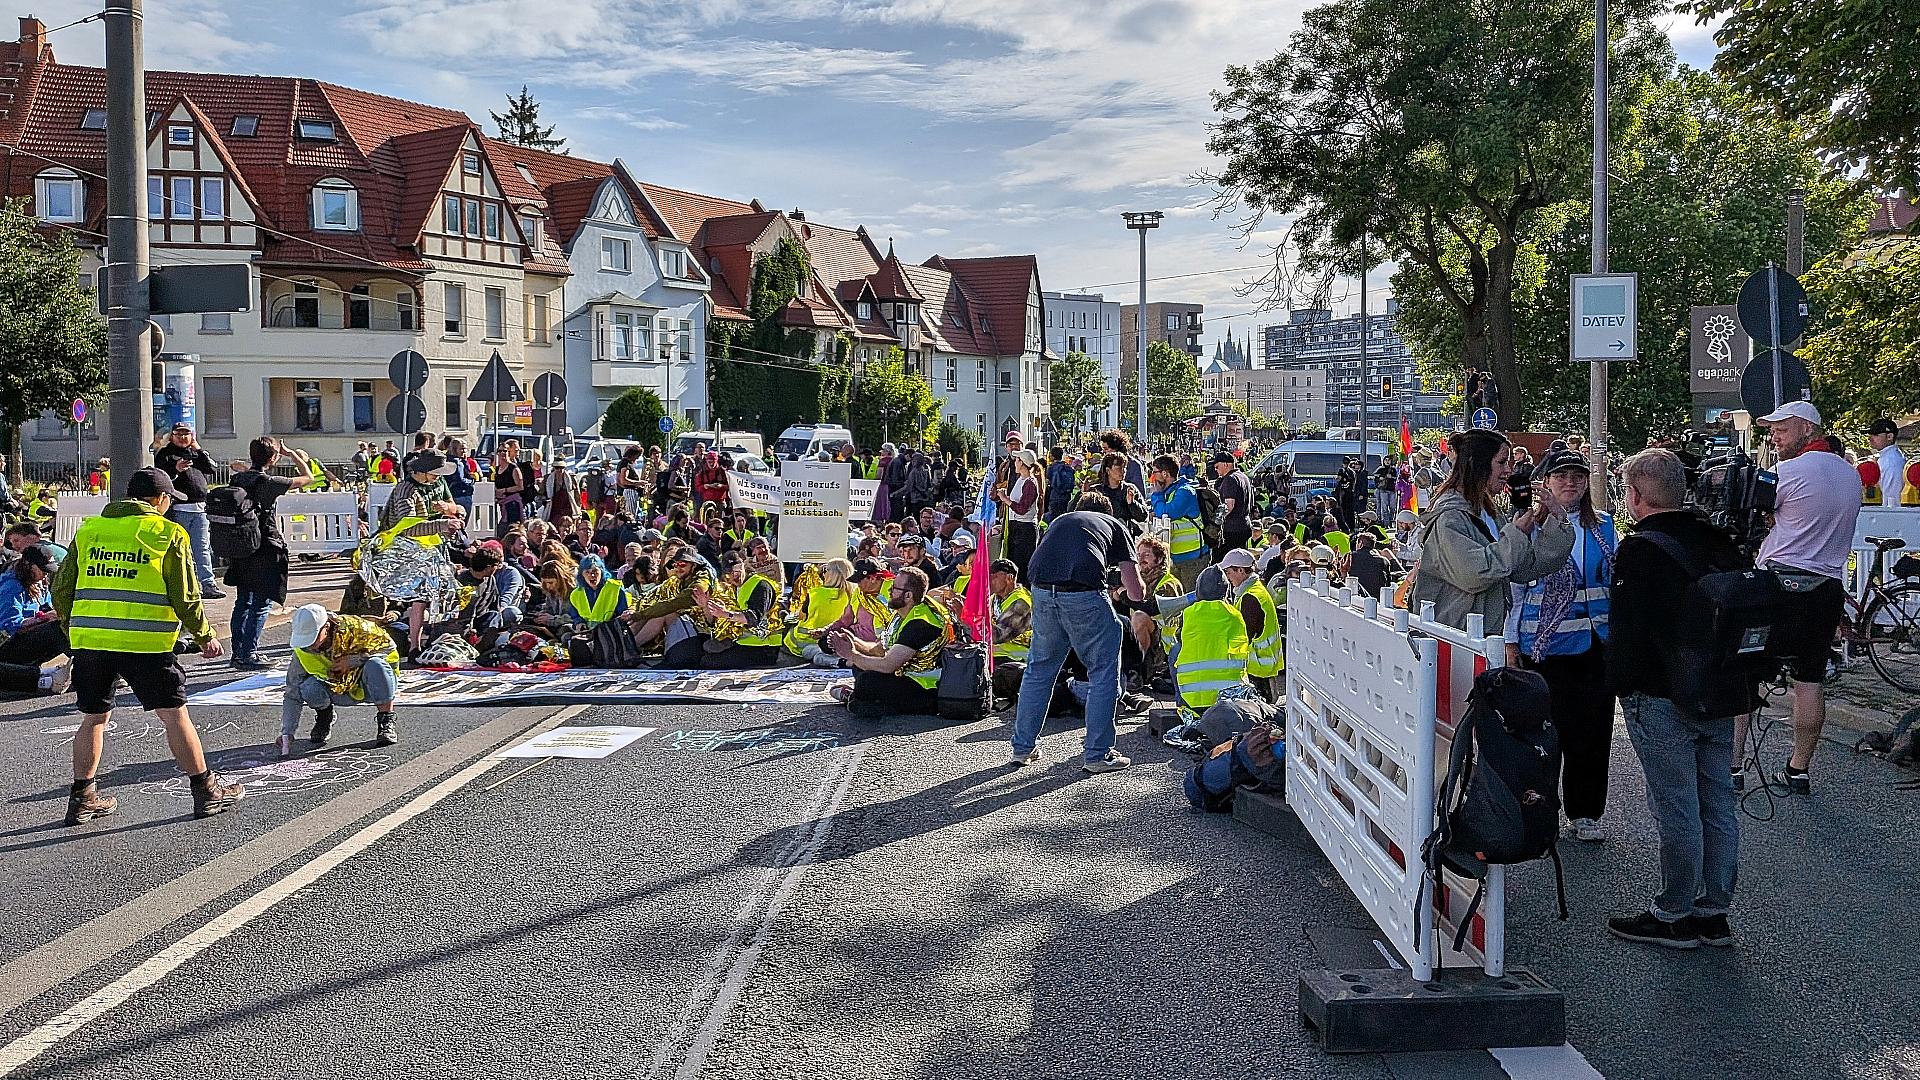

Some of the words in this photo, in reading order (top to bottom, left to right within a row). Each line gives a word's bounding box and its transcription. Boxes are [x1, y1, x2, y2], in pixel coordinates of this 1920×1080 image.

[1582, 316, 1626, 327] DATEV
[1697, 366, 1741, 380] egapark
[784, 479, 802, 488] Von
[807, 480, 841, 489] Berufs
[739, 488, 769, 500] gegen
[784, 490, 813, 499] wegen
[784, 498, 824, 507] antifa-
[784, 508, 843, 517] schistisch.
[89, 546, 151, 565] Niemals
[86, 562, 138, 580] alleine
